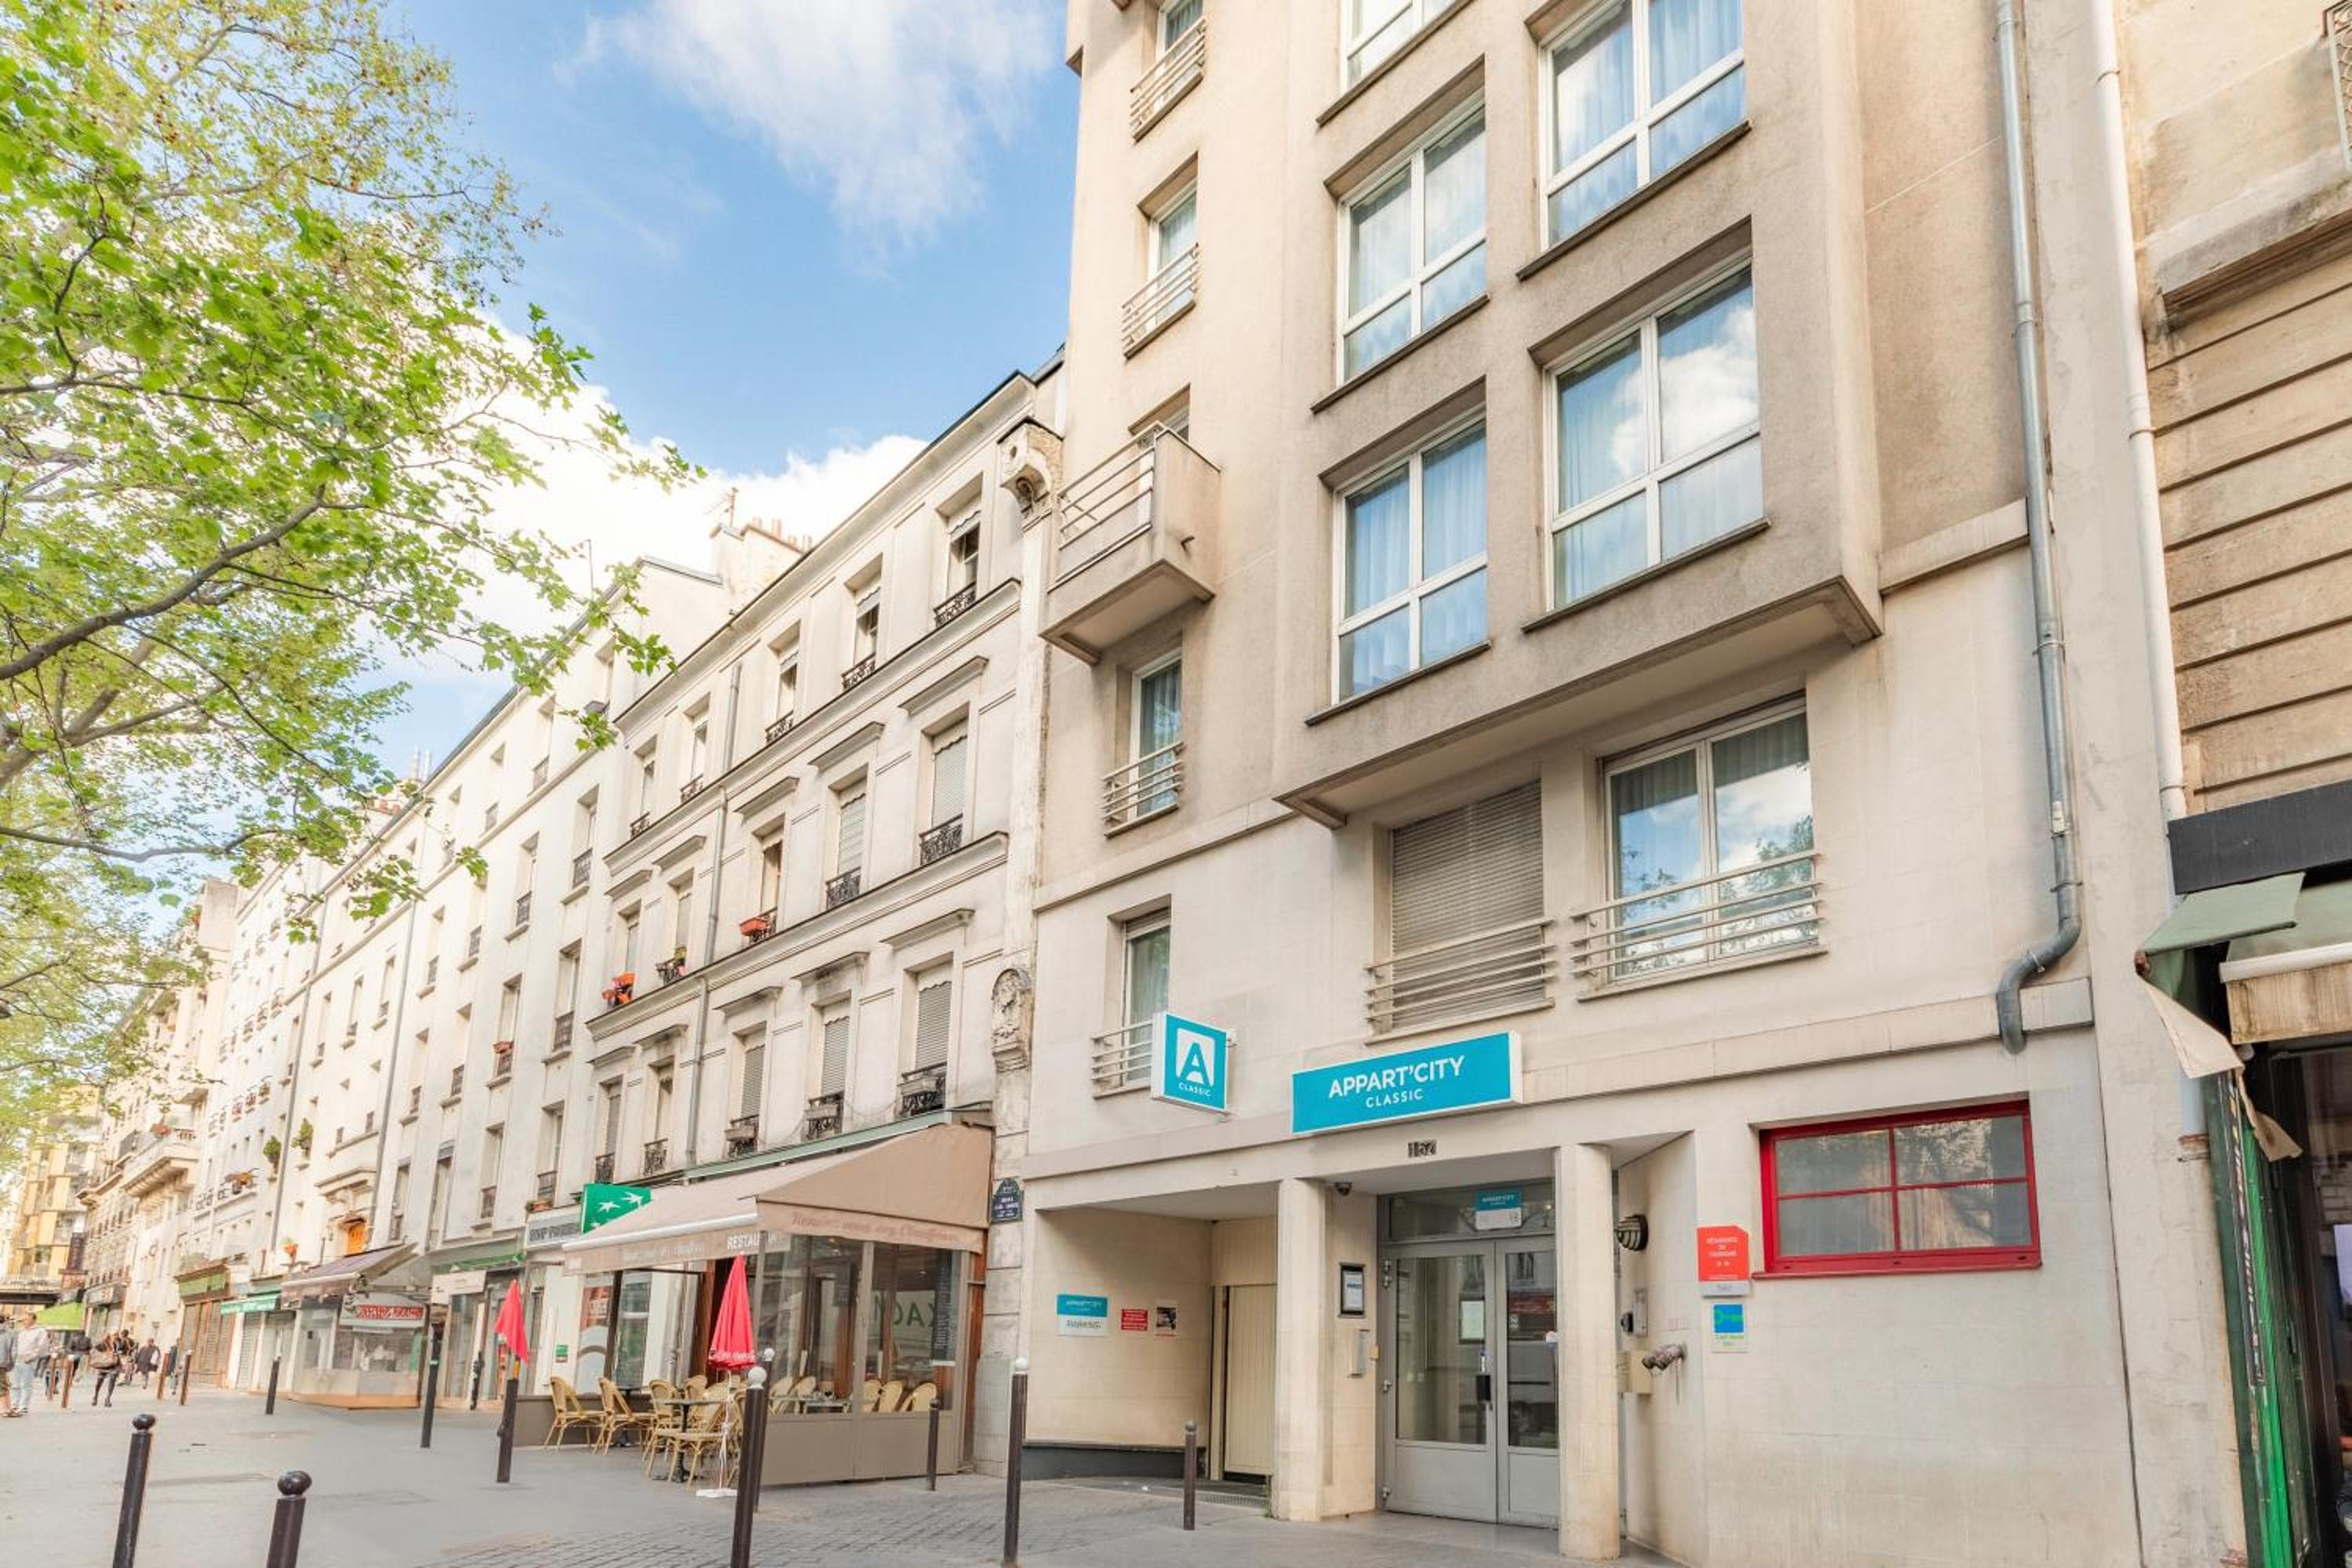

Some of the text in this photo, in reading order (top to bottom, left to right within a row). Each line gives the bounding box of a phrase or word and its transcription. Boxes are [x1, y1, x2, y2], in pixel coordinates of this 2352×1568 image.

[1177, 1040, 1212, 1087] A
[1329, 1055, 1465, 1098] APPART'CITY
[1178, 1082, 1211, 1097] CLASSIC
[1366, 1088, 1424, 1108] CLASSIC
